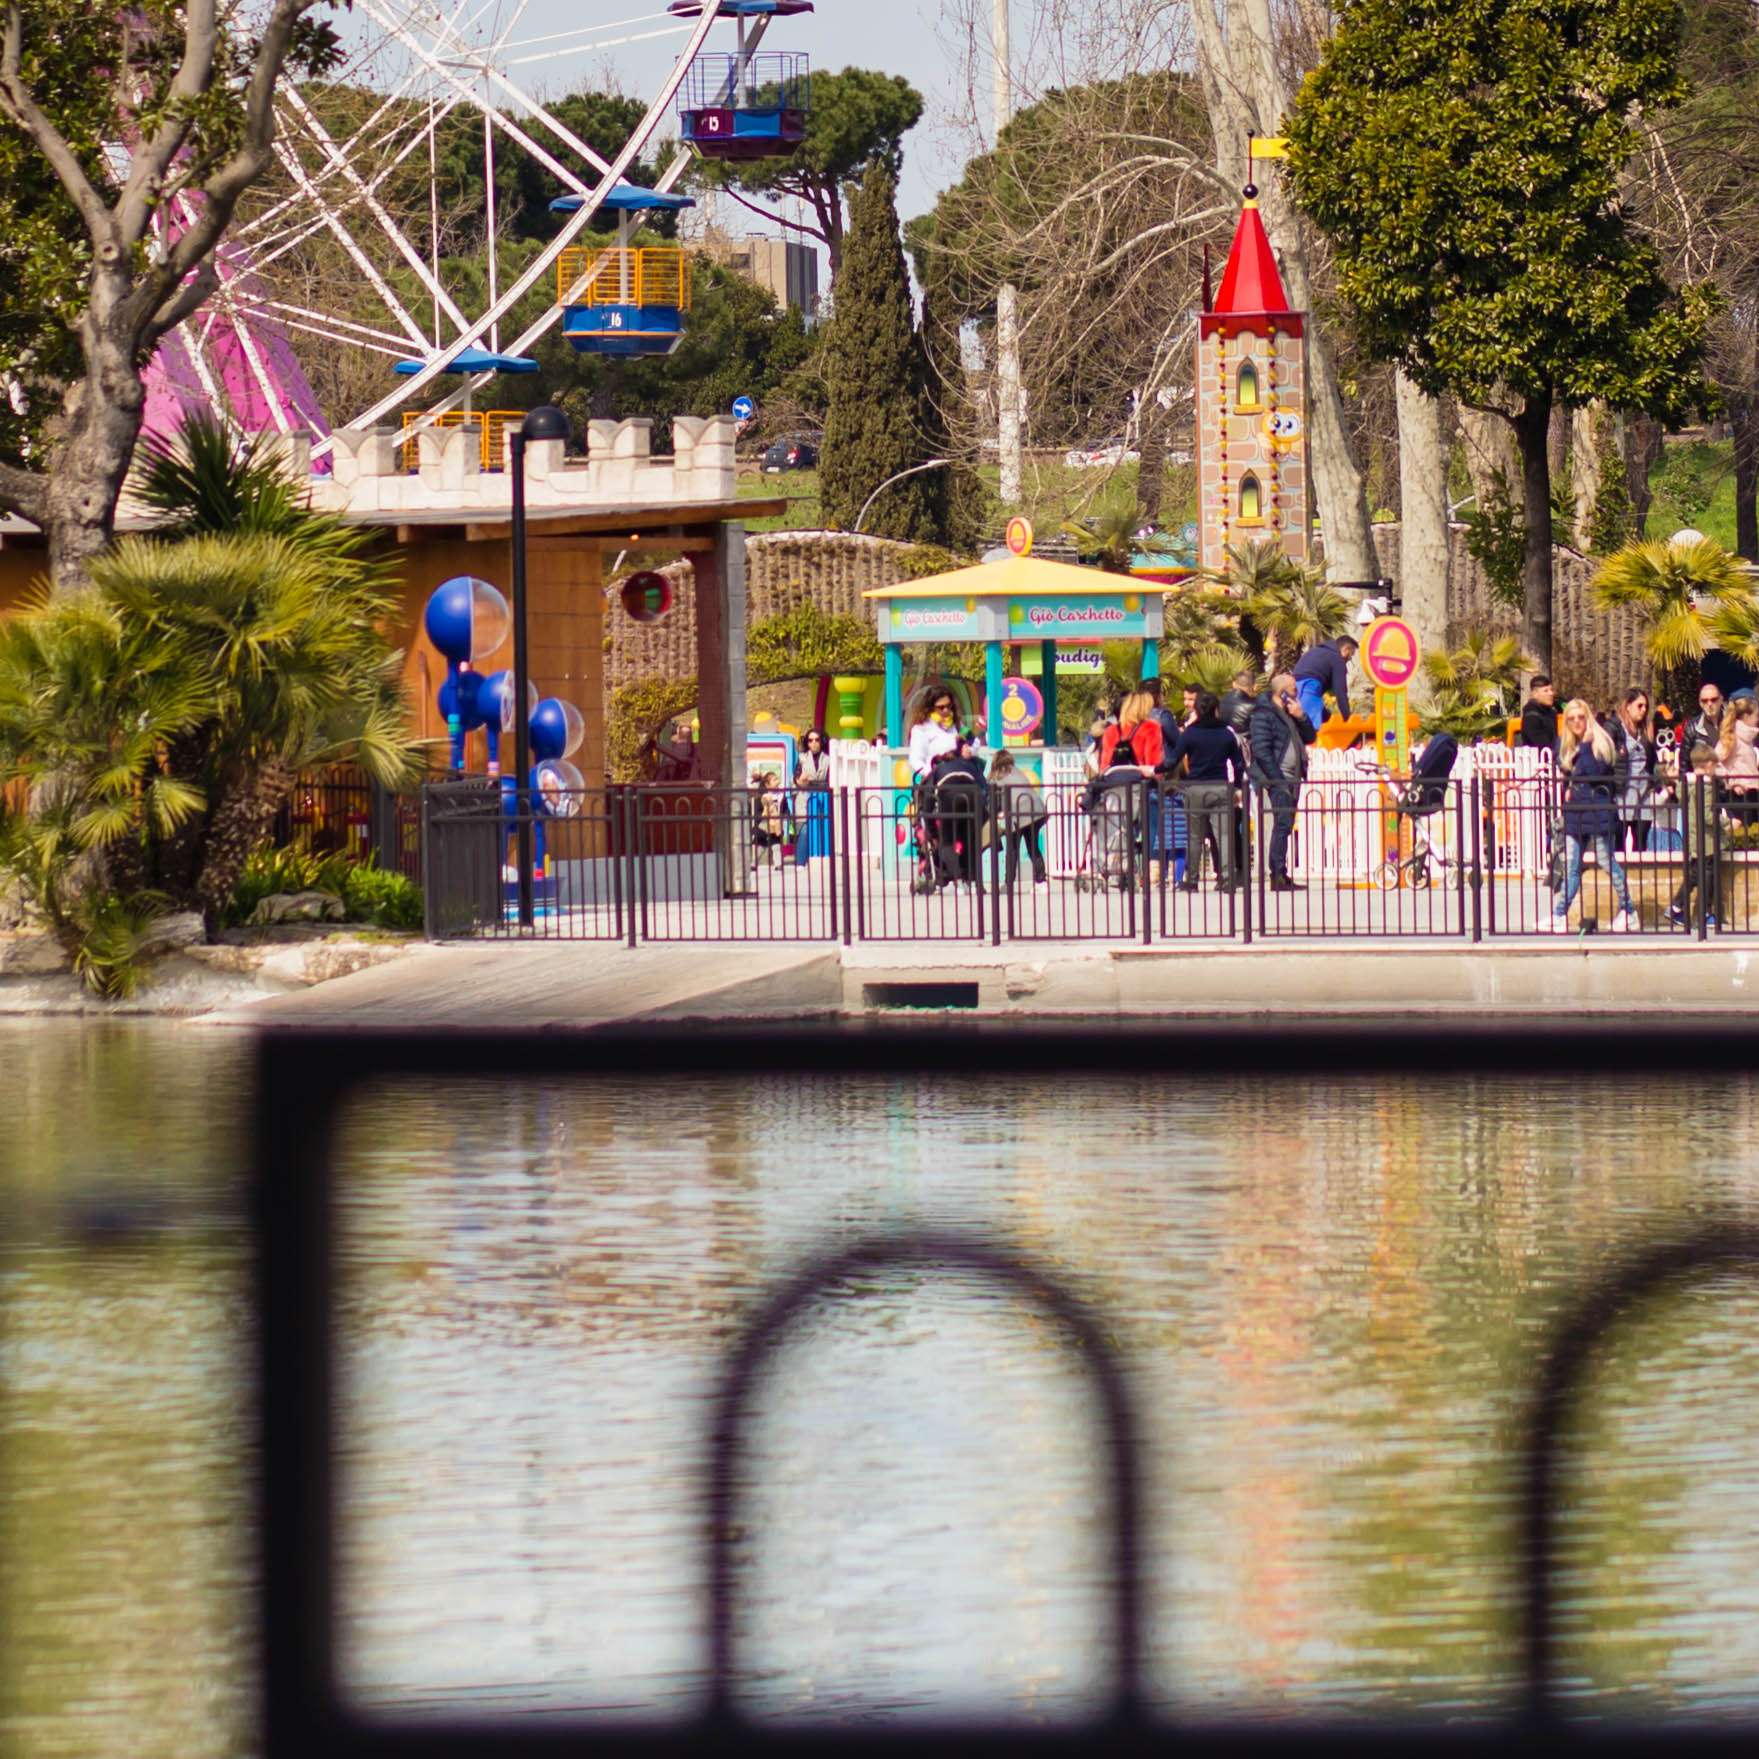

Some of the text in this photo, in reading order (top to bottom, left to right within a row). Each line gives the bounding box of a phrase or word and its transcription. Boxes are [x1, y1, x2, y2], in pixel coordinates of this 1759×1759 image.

[709, 116, 719, 131] 15
[611, 312, 622, 327] 16
[1029, 607, 1125, 625] Giò Caschetto
[1008, 684, 1018, 697] 2
